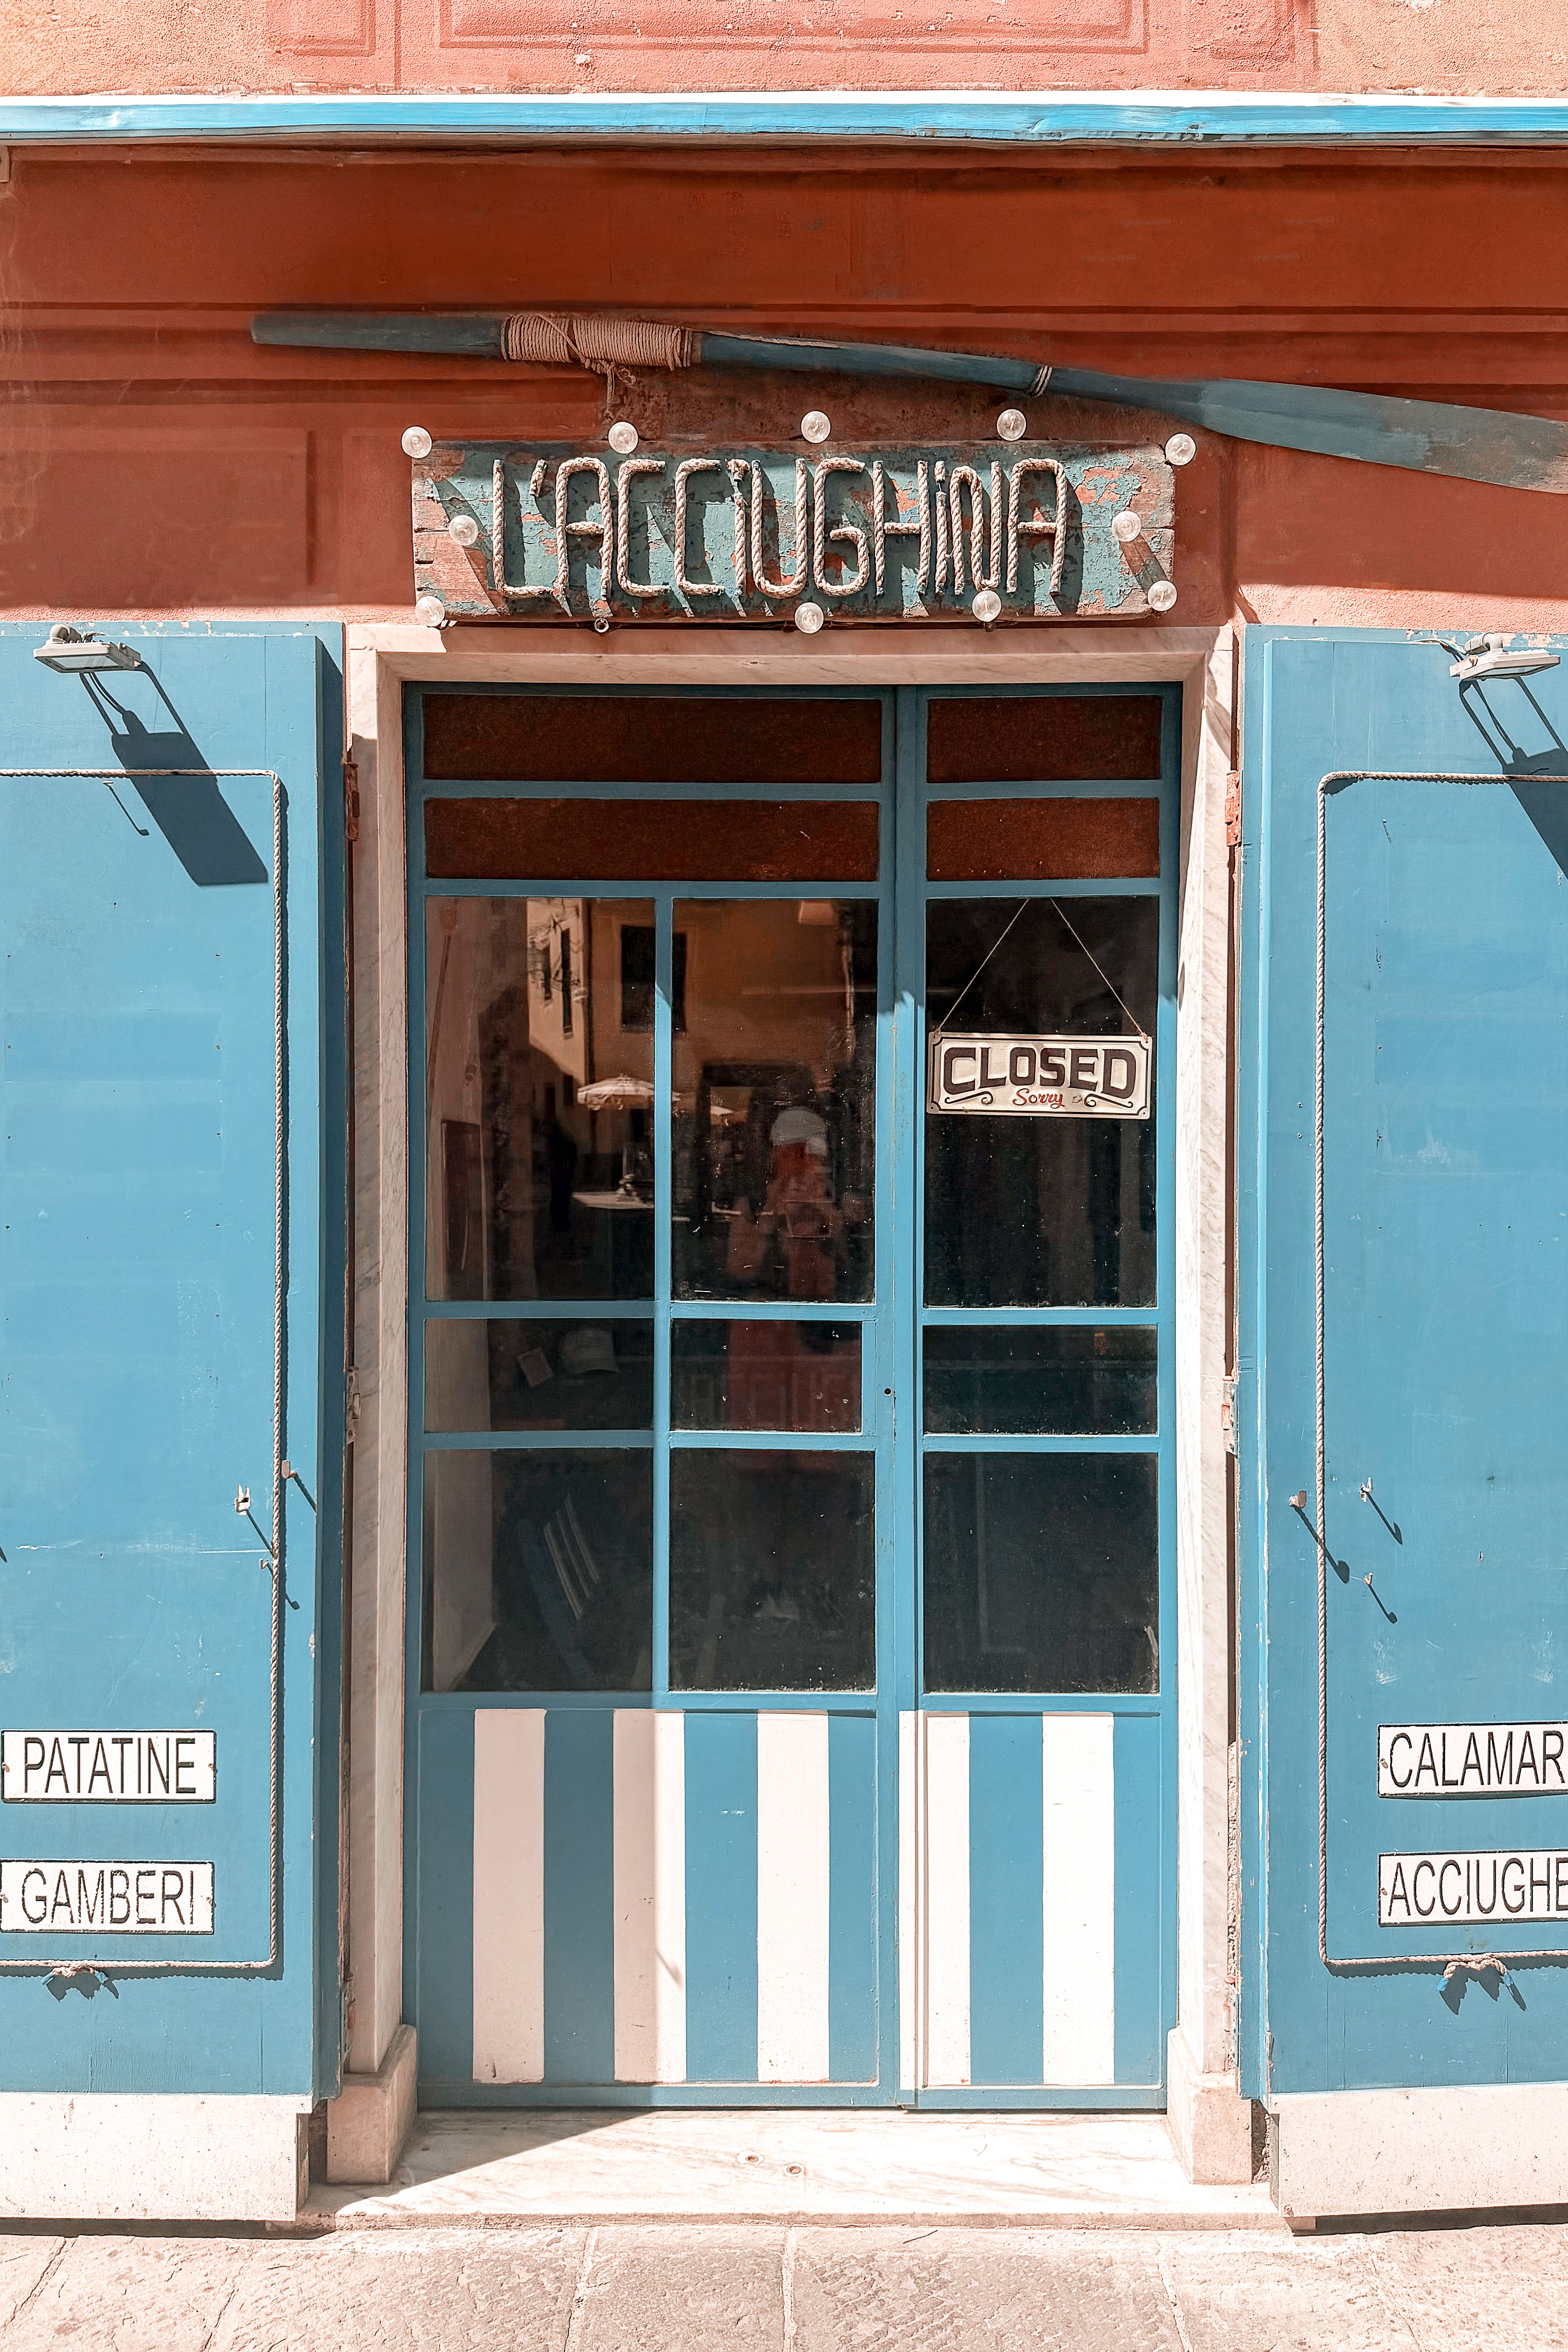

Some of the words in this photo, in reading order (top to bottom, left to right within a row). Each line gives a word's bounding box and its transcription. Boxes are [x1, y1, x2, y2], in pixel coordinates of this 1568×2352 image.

[943, 1047, 1136, 1099] CLOSED
[1012, 1088, 1065, 1109] Sorry
[24, 1737, 196, 1794] PATATINE
[21, 1868, 193, 1925] GAMBERI
[1388, 1857, 1568, 1916] ACCIUGHE
